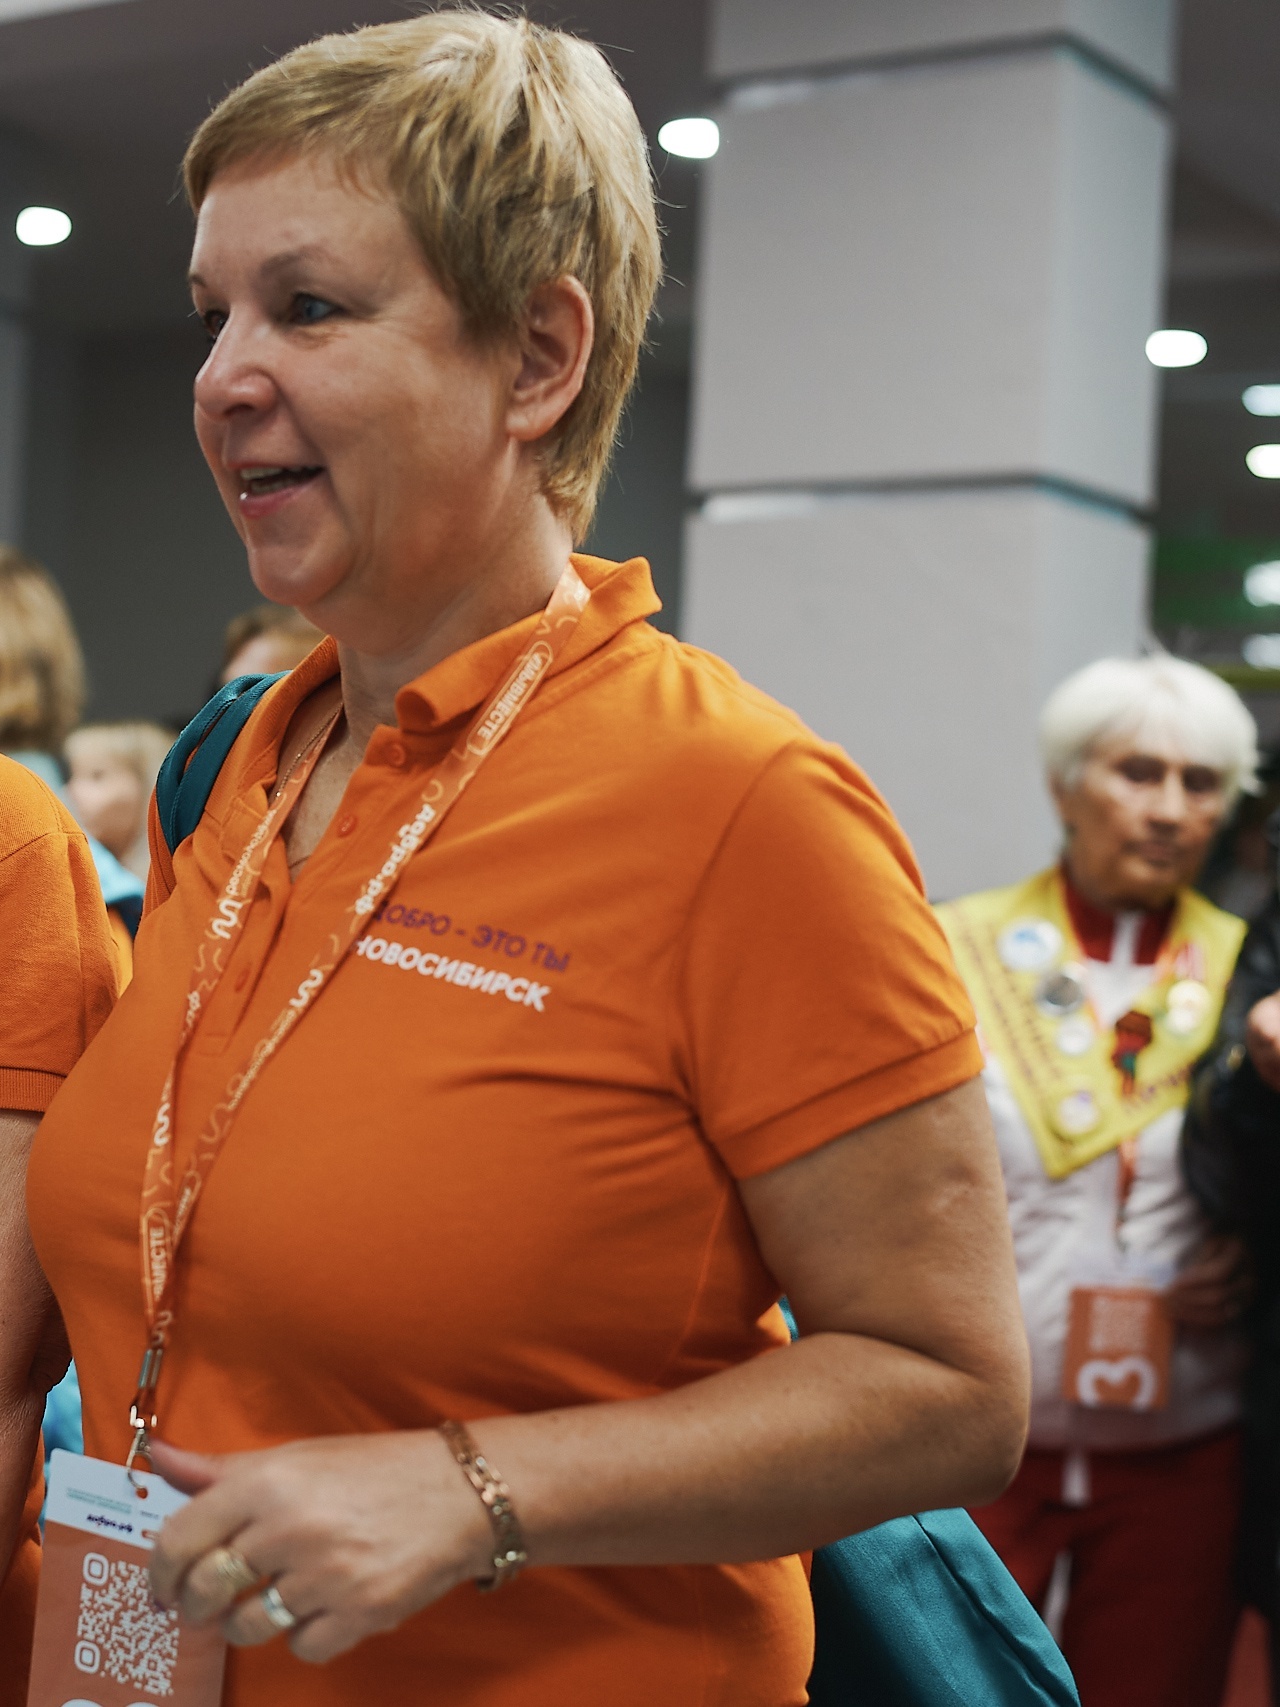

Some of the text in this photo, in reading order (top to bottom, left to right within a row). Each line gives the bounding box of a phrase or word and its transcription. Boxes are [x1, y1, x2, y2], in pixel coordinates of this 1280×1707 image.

[355, 803, 435, 915] добро.рф
[375, 904, 452, 936] ОБРО
[472, 924, 527, 958] ЭТО
[532, 942, 571, 974] ТЫ
